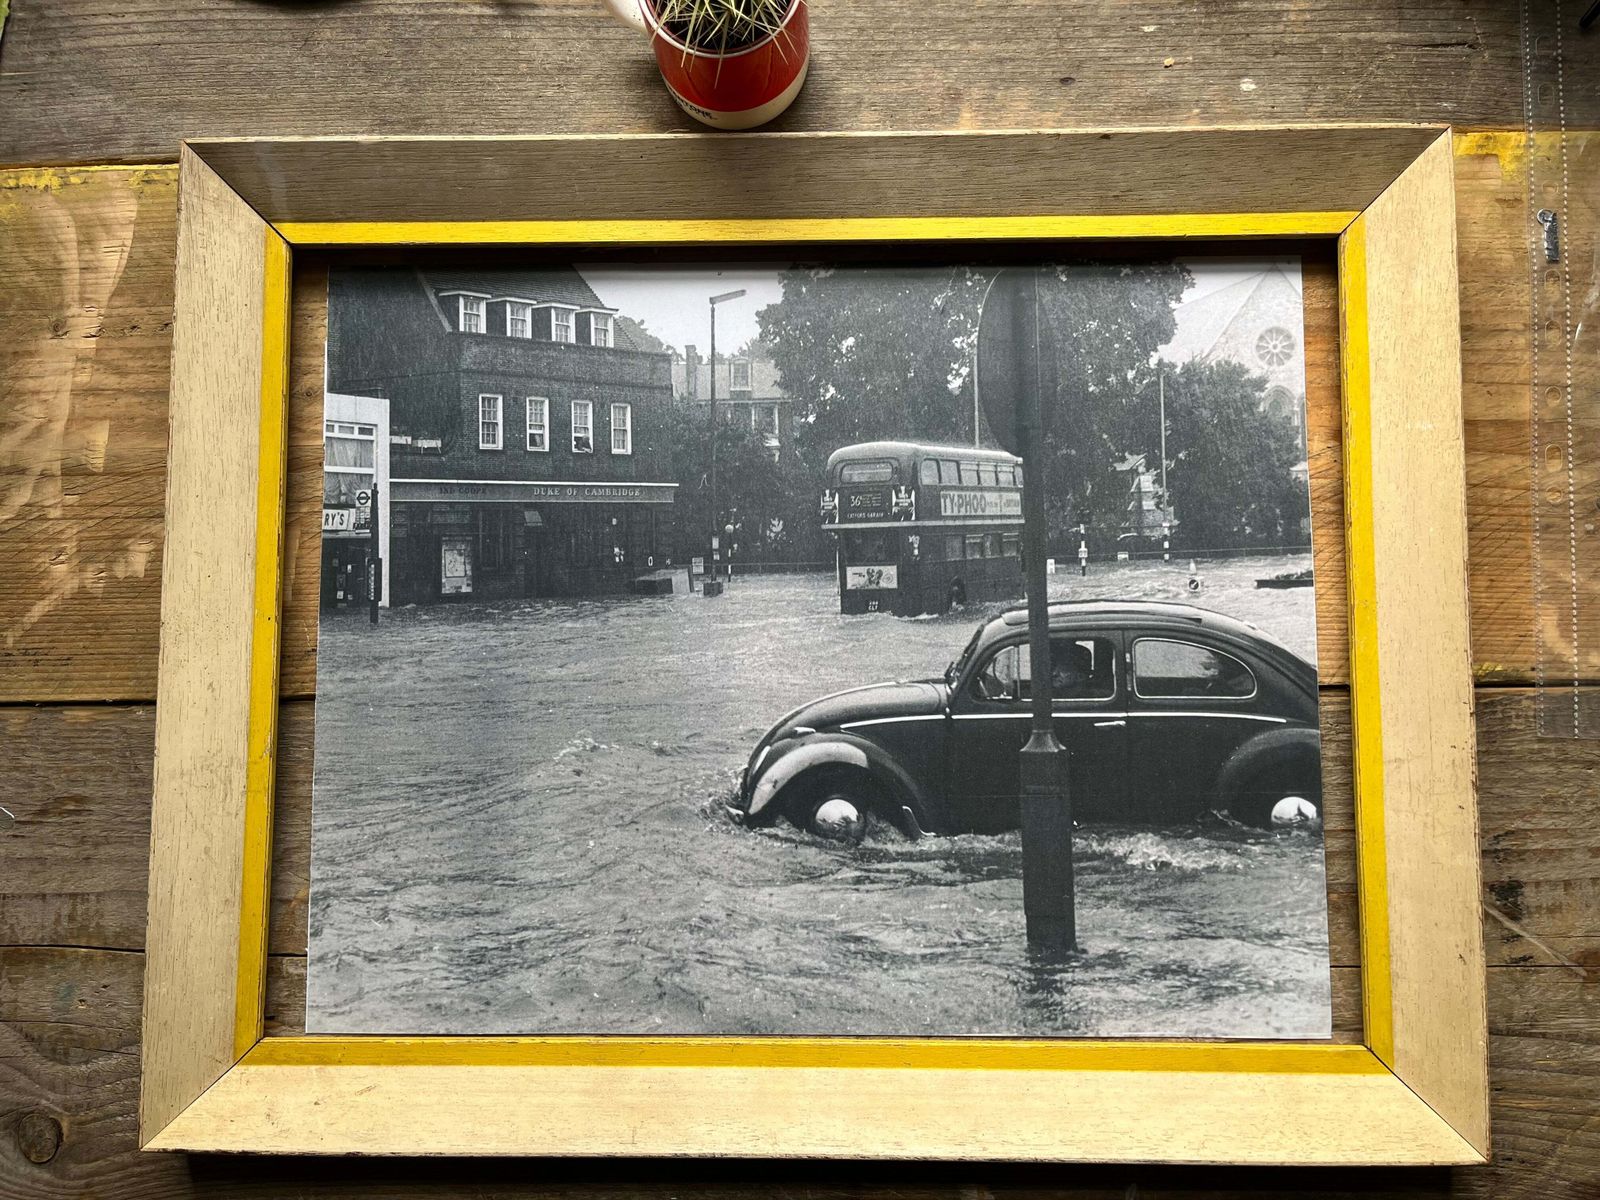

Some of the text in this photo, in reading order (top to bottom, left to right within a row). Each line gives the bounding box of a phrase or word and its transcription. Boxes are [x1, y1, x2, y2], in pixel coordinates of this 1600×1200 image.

[533, 487, 641, 496] DUKE OF CAMBRIDGE
[324, 512, 345, 527] RY'S
